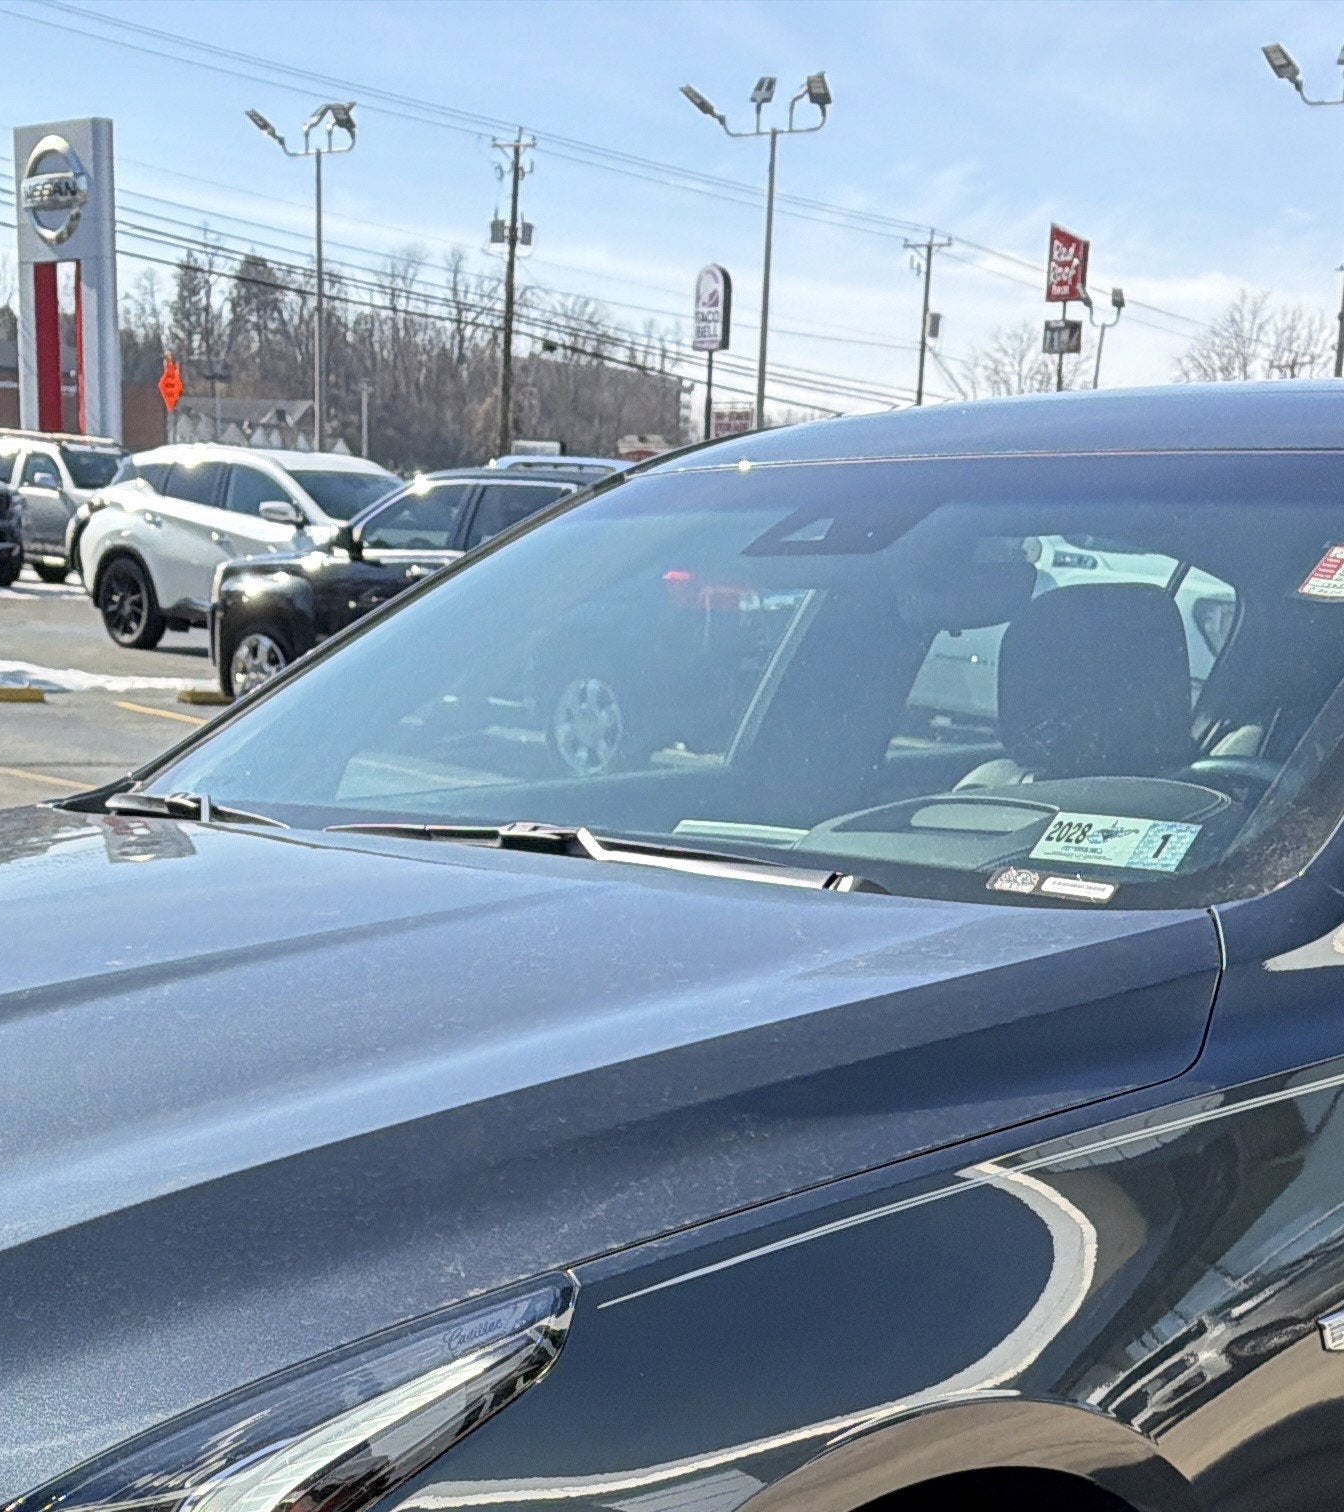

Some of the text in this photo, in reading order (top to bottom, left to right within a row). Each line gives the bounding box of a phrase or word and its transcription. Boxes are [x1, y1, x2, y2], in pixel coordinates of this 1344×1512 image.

[23, 179, 79, 199] NISSAN
[696, 311, 720, 323] TACO
[696, 325, 719, 338] BELL
[1045, 820, 1093, 845] 2028
[1152, 833, 1174, 859] 1
